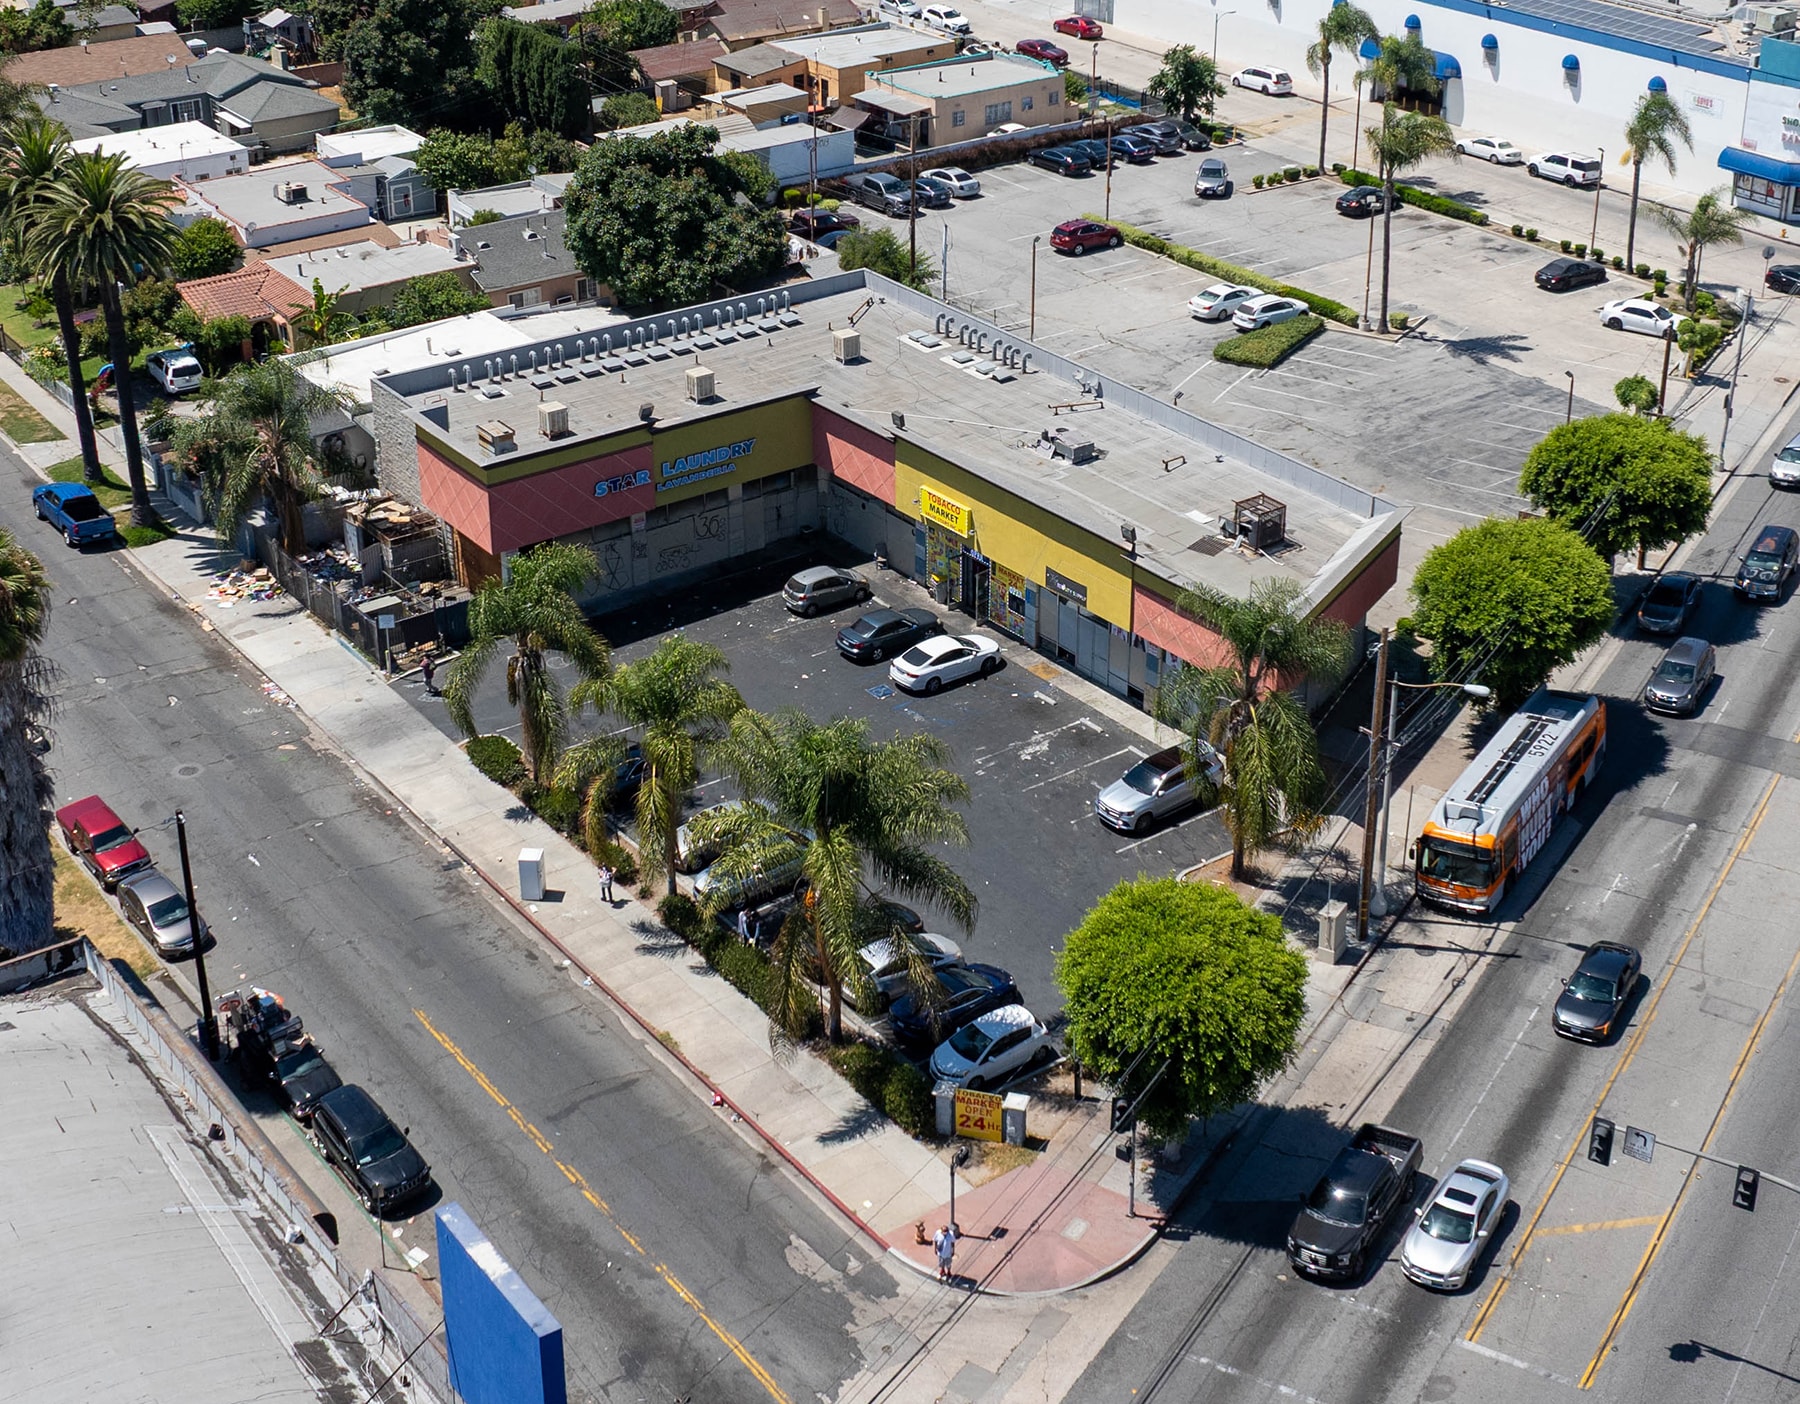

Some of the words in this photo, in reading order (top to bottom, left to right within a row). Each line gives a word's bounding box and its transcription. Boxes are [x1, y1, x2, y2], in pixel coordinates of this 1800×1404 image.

[1781, 115, 1800, 128] SHO
[594, 469, 652, 498] STAR
[661, 437, 757, 478] LAUNDRY
[656, 462, 737, 492] LAVANDERIA
[927, 491, 961, 516] TOBACCO
[929, 503, 959, 525] MARKET
[1528, 733, 1559, 757] 5922
[1520, 775, 1550, 826] WHO
[1520, 792, 1553, 850] HURT
[956, 1096, 1002, 1110] MARKET
[957, 1090, 1002, 1102] TOBACCO
[959, 1114, 986, 1131] 24
[965, 1105, 993, 1117] OPEN
